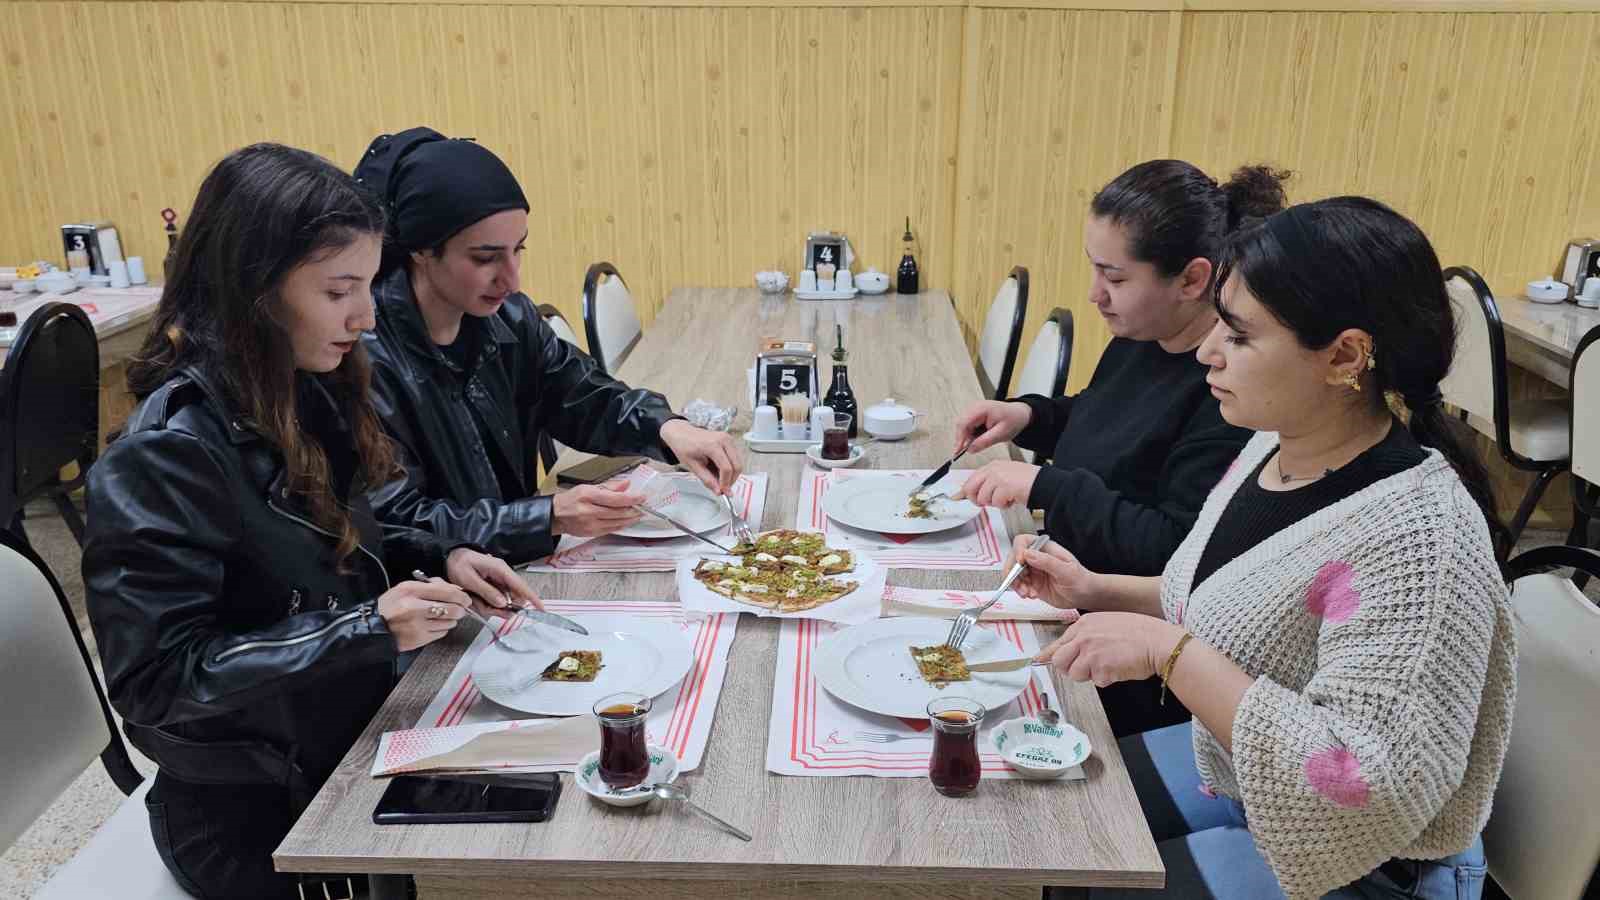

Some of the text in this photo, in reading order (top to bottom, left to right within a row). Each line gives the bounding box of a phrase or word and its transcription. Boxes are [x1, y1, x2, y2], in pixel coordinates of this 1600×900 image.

[73, 235, 85, 250] 3
[820, 246, 833, 262] 4
[779, 369, 798, 391] 5
